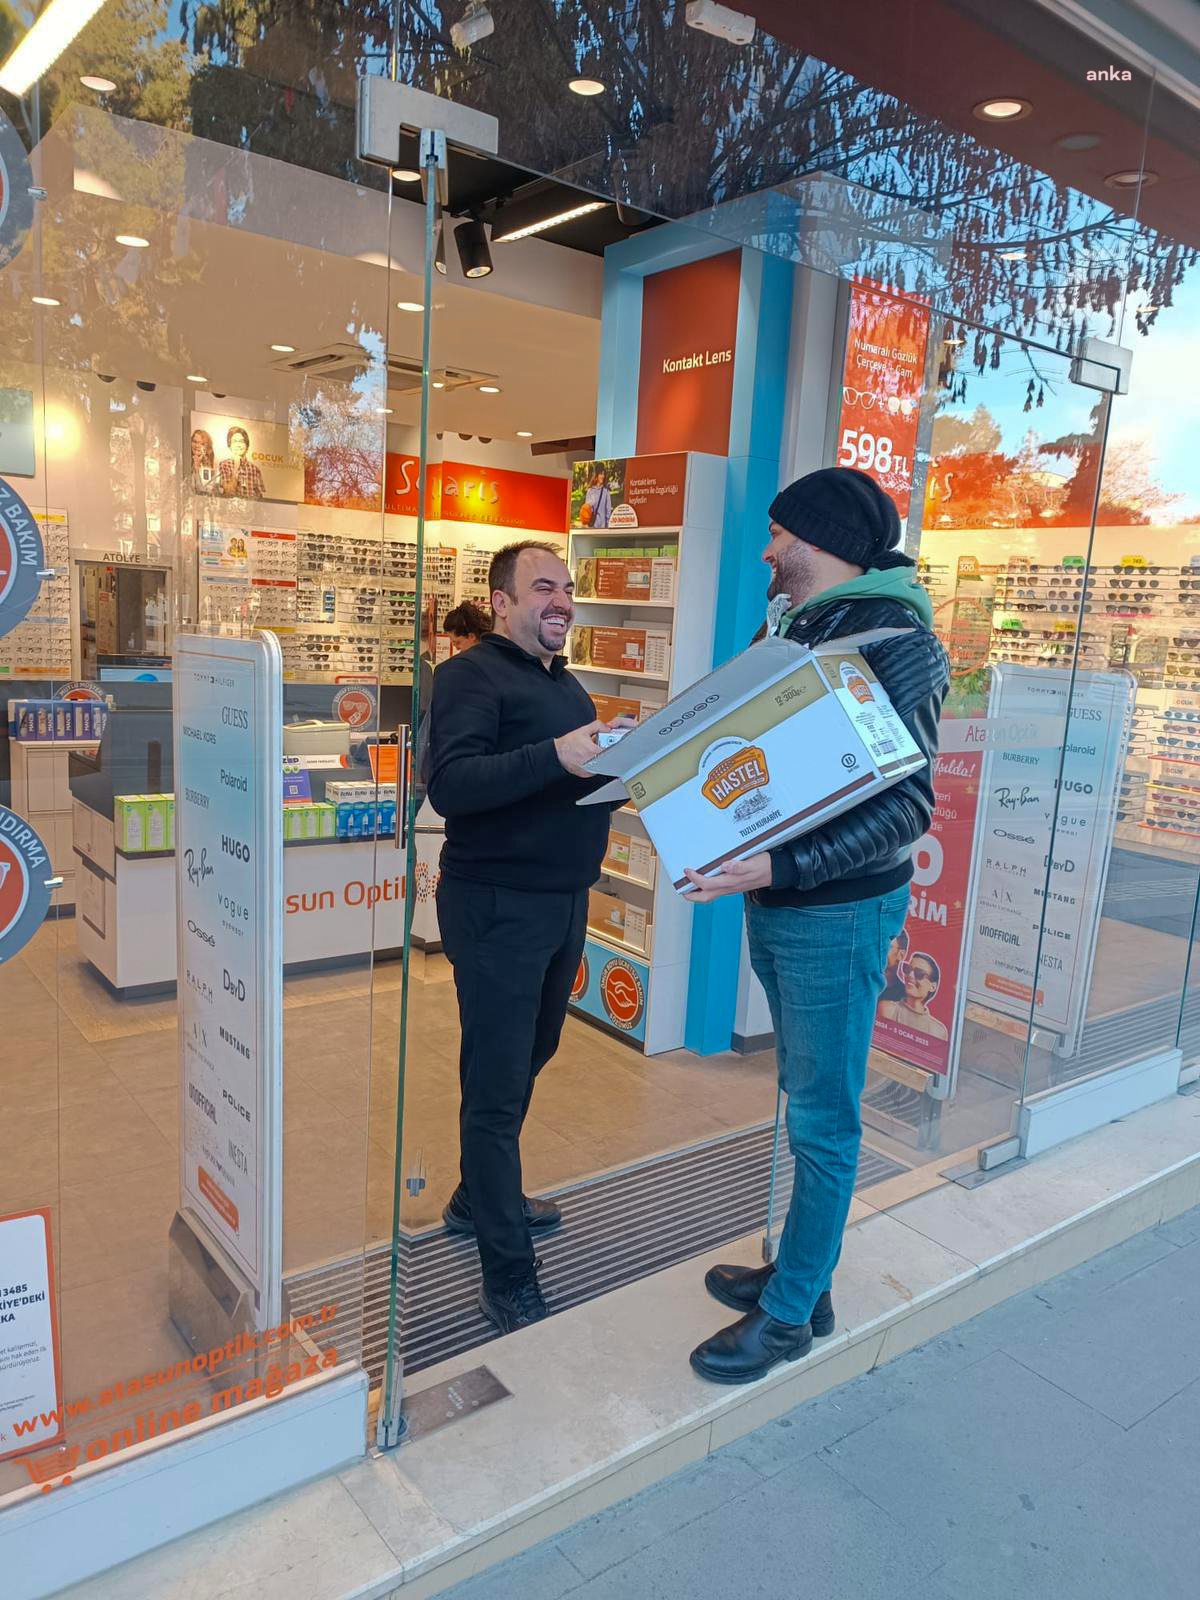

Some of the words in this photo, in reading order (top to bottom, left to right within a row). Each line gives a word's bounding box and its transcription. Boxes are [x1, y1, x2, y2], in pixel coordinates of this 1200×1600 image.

[662, 353, 703, 374] Kontakt
[705, 350, 732, 366] Lens
[396, 459, 500, 504] Slaris
[4, 503, 38, 566] BAKIM
[221, 705, 249, 730] GUESS
[1002, 751, 1040, 766] BURBERRY
[1058, 743, 1097, 756] olaroid
[220, 768, 248, 792] Polaroid
[1044, 811, 1087, 828] vgue
[221, 833, 251, 863] HUGO
[286, 890, 335, 914] sun
[979, 923, 1021, 947] UNOFFICIAL
[219, 1025, 251, 1060] MUSTANG
[222, 1088, 251, 1122] POLICE
[85, 1400, 202, 1462] online
[210, 1346, 338, 1414] mağaza
